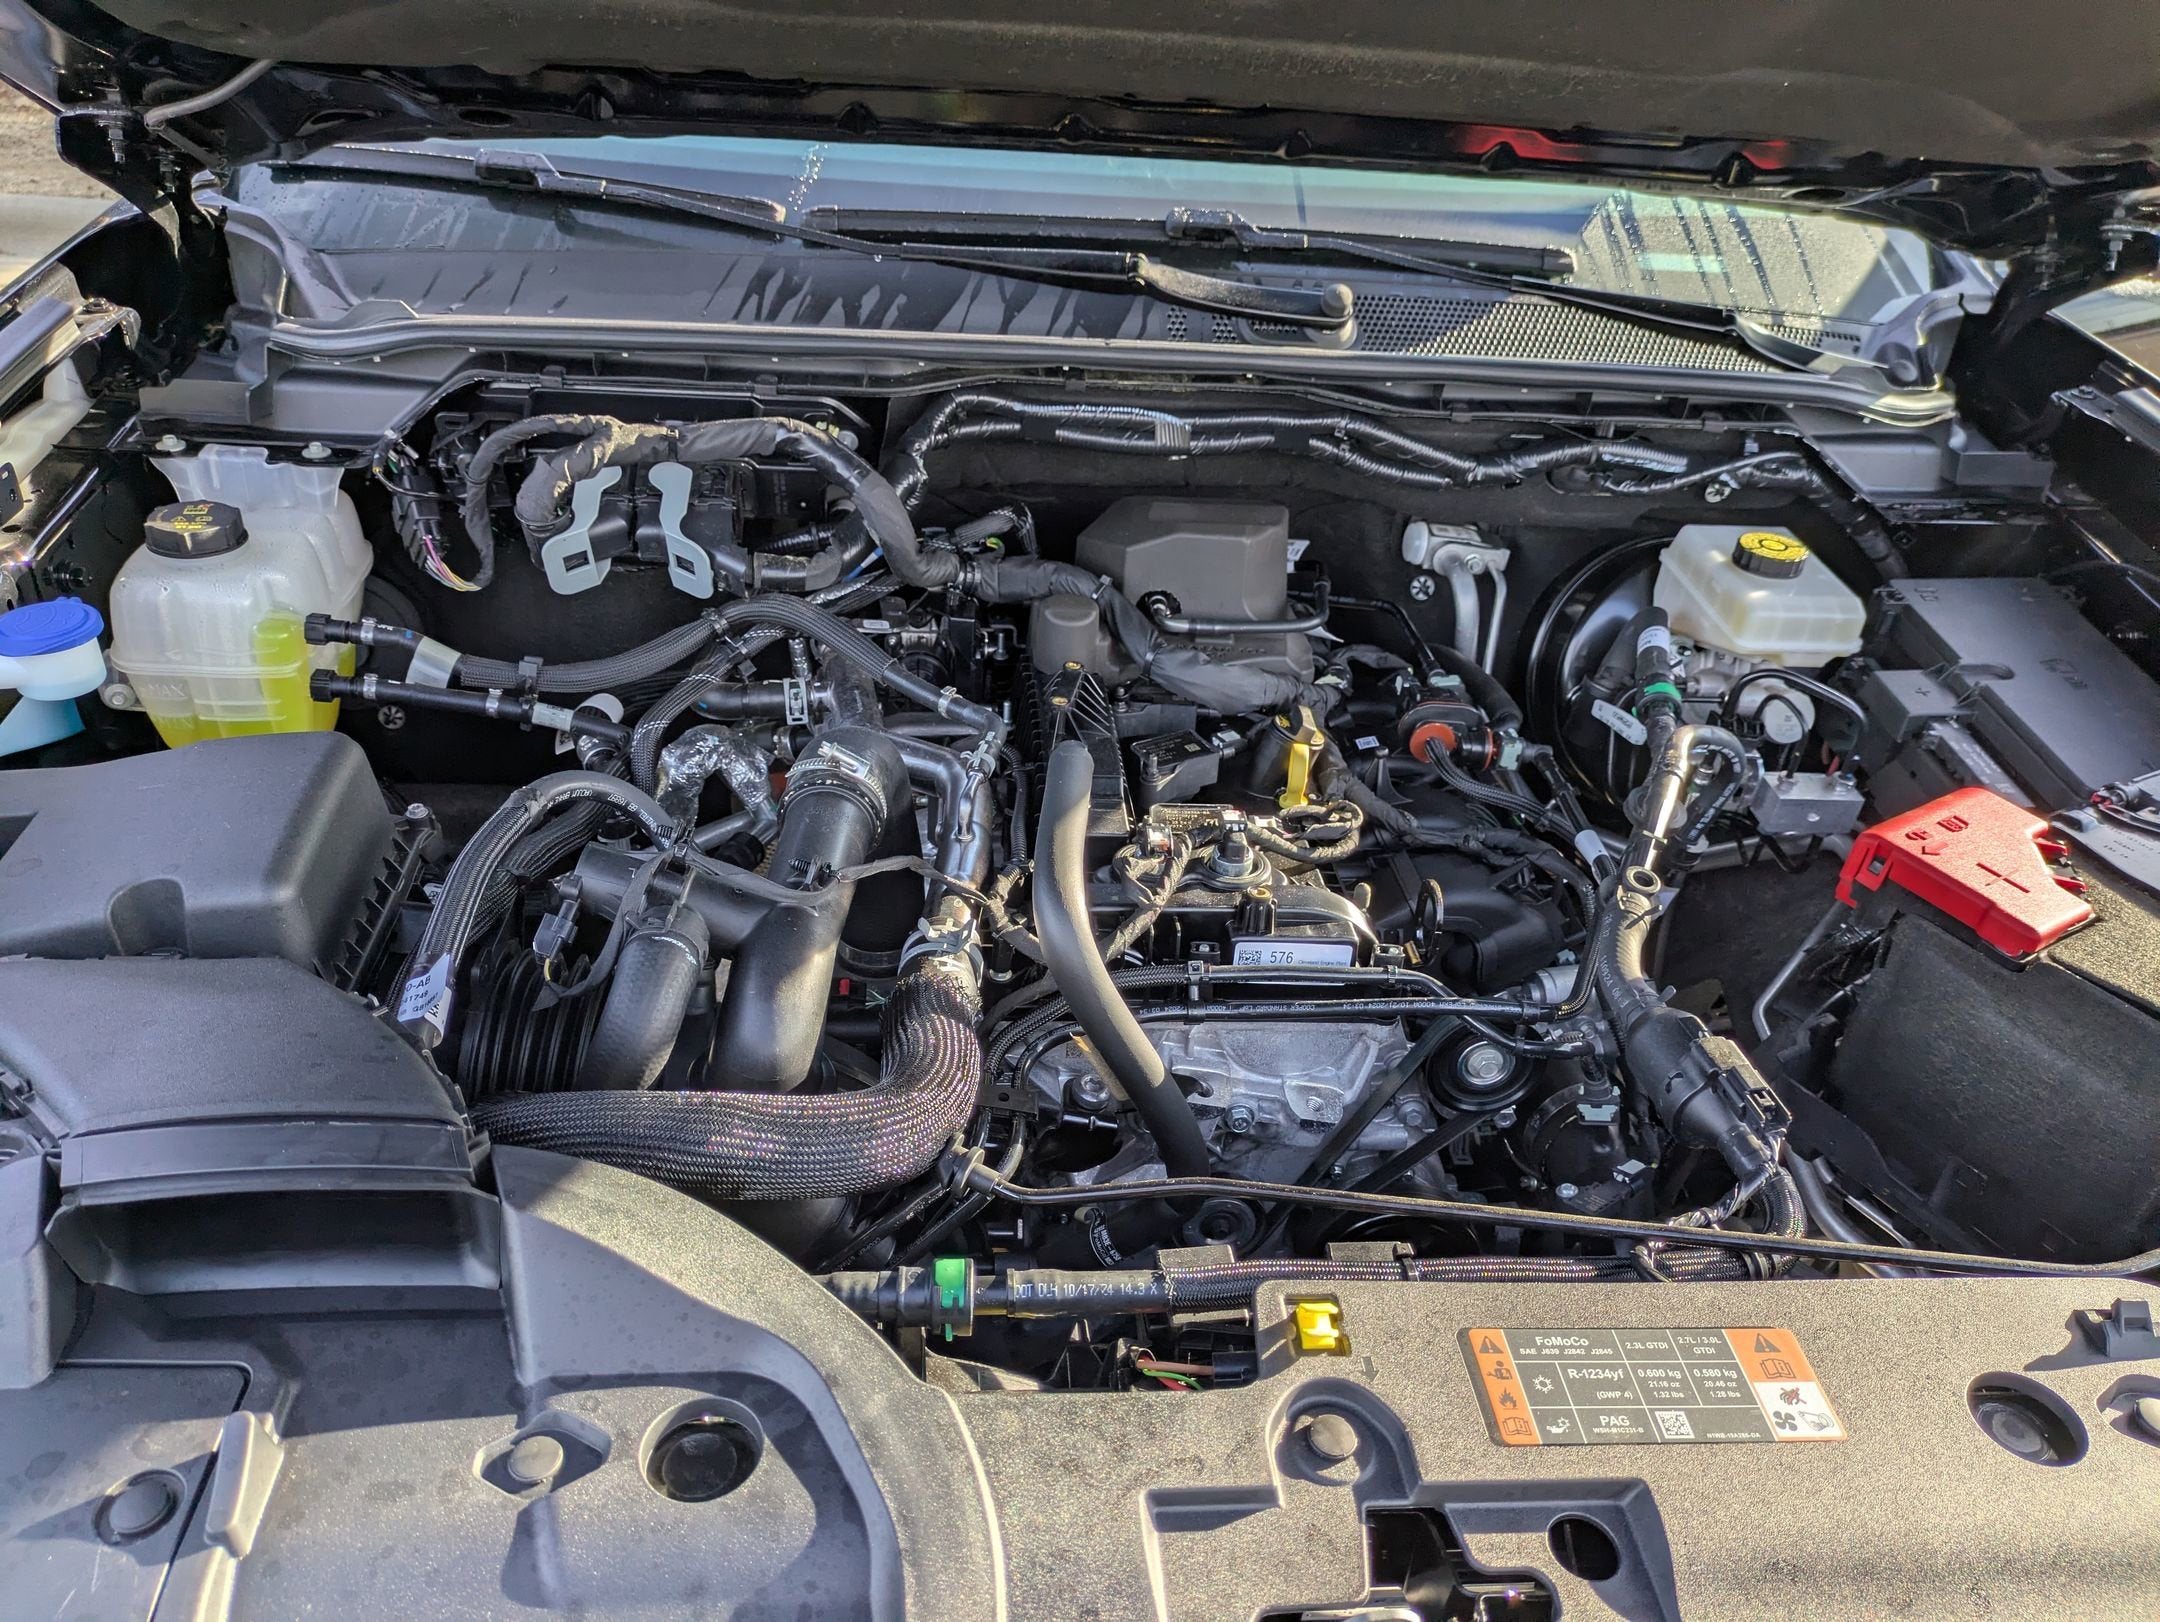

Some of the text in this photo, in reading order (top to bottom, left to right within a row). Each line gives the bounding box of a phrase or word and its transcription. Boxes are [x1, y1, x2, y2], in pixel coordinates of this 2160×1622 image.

[1269, 950, 1294, 964] 576
[1120, 1283, 1145, 1296] 14.3
[1535, 1336, 1589, 1346] FoMoCo
[1625, 1341, 1645, 1349] 2.3L
[1694, 1347, 1716, 1355] GTDI
[1567, 1368, 1624, 1381] R-1234yf
[1637, 1369, 1682, 1380] 0.600 kg
[1693, 1369, 1738, 1380] 0.580 kg
[1596, 1391, 1634, 1400] (GWP 4)
[1599, 1415, 1631, 1427] PAG
